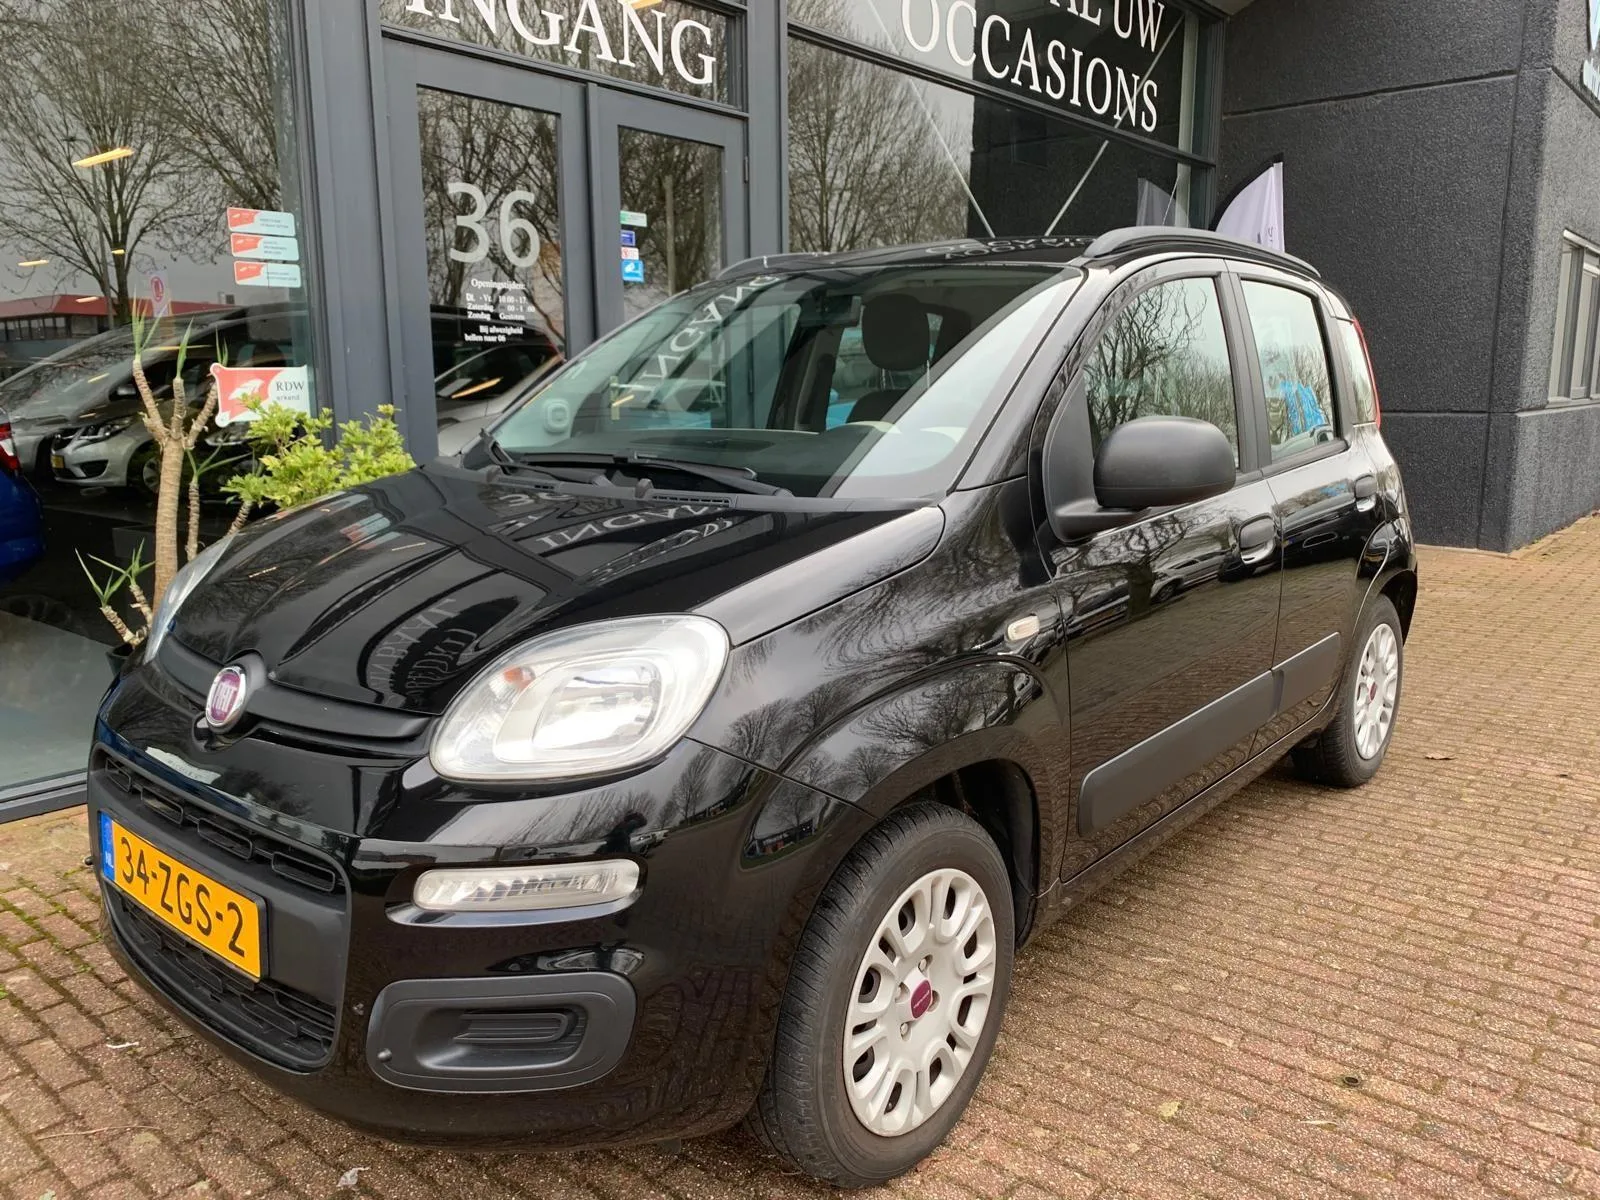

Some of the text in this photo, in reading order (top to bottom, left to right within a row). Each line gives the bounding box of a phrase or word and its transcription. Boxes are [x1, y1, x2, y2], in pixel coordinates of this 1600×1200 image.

[901, 0, 1158, 132] OCCASIONS
[1113, 0, 1165, 53] UW
[447, 182, 540, 268] 36
[276, 381, 305, 393] RDW
[120, 836, 246, 958] 34-ZGS-2
